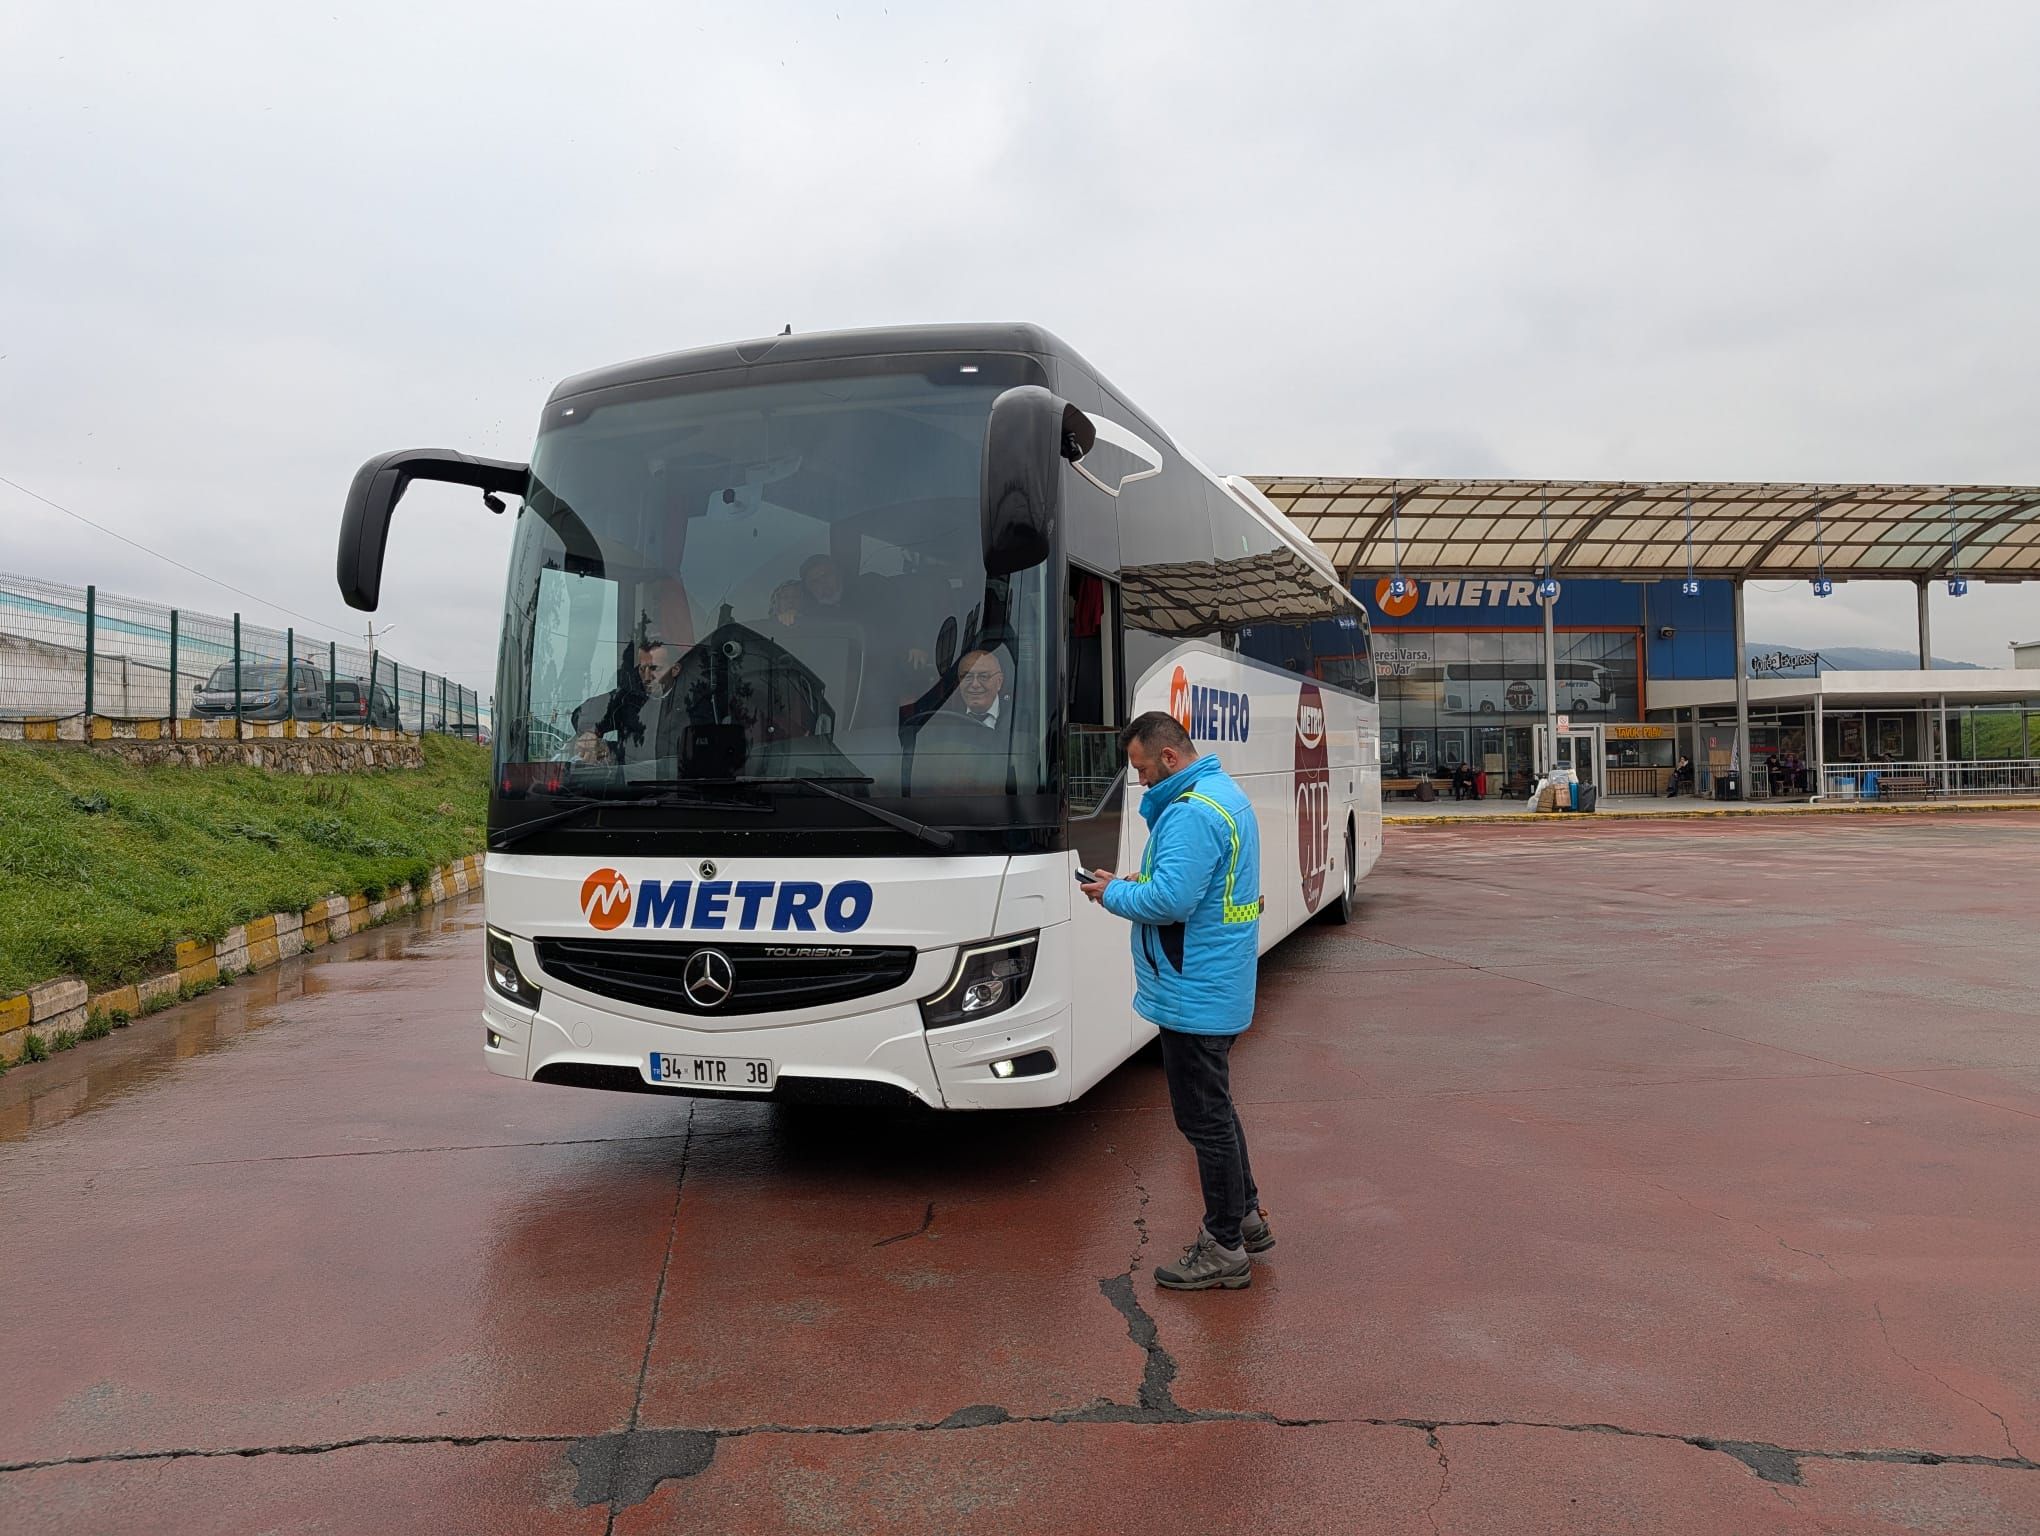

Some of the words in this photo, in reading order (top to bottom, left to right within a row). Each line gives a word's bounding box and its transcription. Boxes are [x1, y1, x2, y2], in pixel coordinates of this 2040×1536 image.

[1395, 581, 1405, 593] 3
[1425, 579, 1561, 606] METRO
[1546, 582, 1556, 593] 4
[1690, 582, 1698, 593] 5
[1822, 581, 1831, 592] 6
[1957, 581, 1966, 592] 7
[1375, 648, 1398, 660] eresi
[1399, 649, 1431, 662] Varsa,
[1376, 663, 1392, 675] tro
[1190, 684, 1250, 743] METRO
[1300, 704, 1322, 735] METRO
[632, 880, 873, 933] METRO
[764, 947, 853, 957] TOURISMO
[661, 1057, 682, 1079] 34
[693, 1059, 727, 1082] MTR
[745, 1062, 768, 1084] 38
